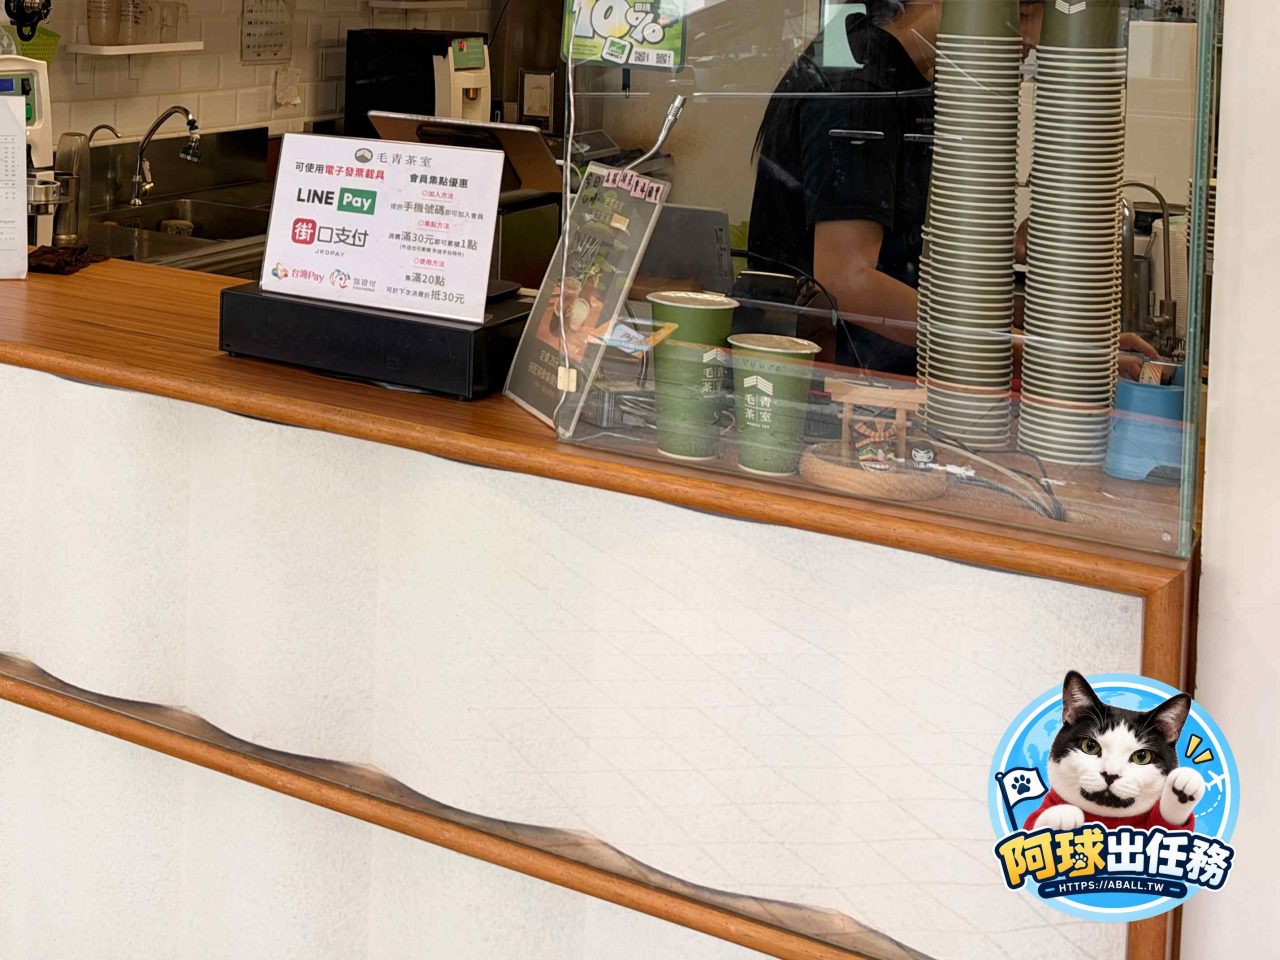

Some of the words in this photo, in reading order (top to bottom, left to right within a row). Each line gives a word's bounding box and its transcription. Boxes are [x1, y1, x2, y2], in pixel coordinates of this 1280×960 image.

[376, 152, 432, 168] 毛青茶室
[296, 162, 385, 180] 可使用電子發票載具
[410, 173, 468, 188] 會員集點優惠
[297, 188, 335, 205] LINE
[342, 193, 372, 211] Pay
